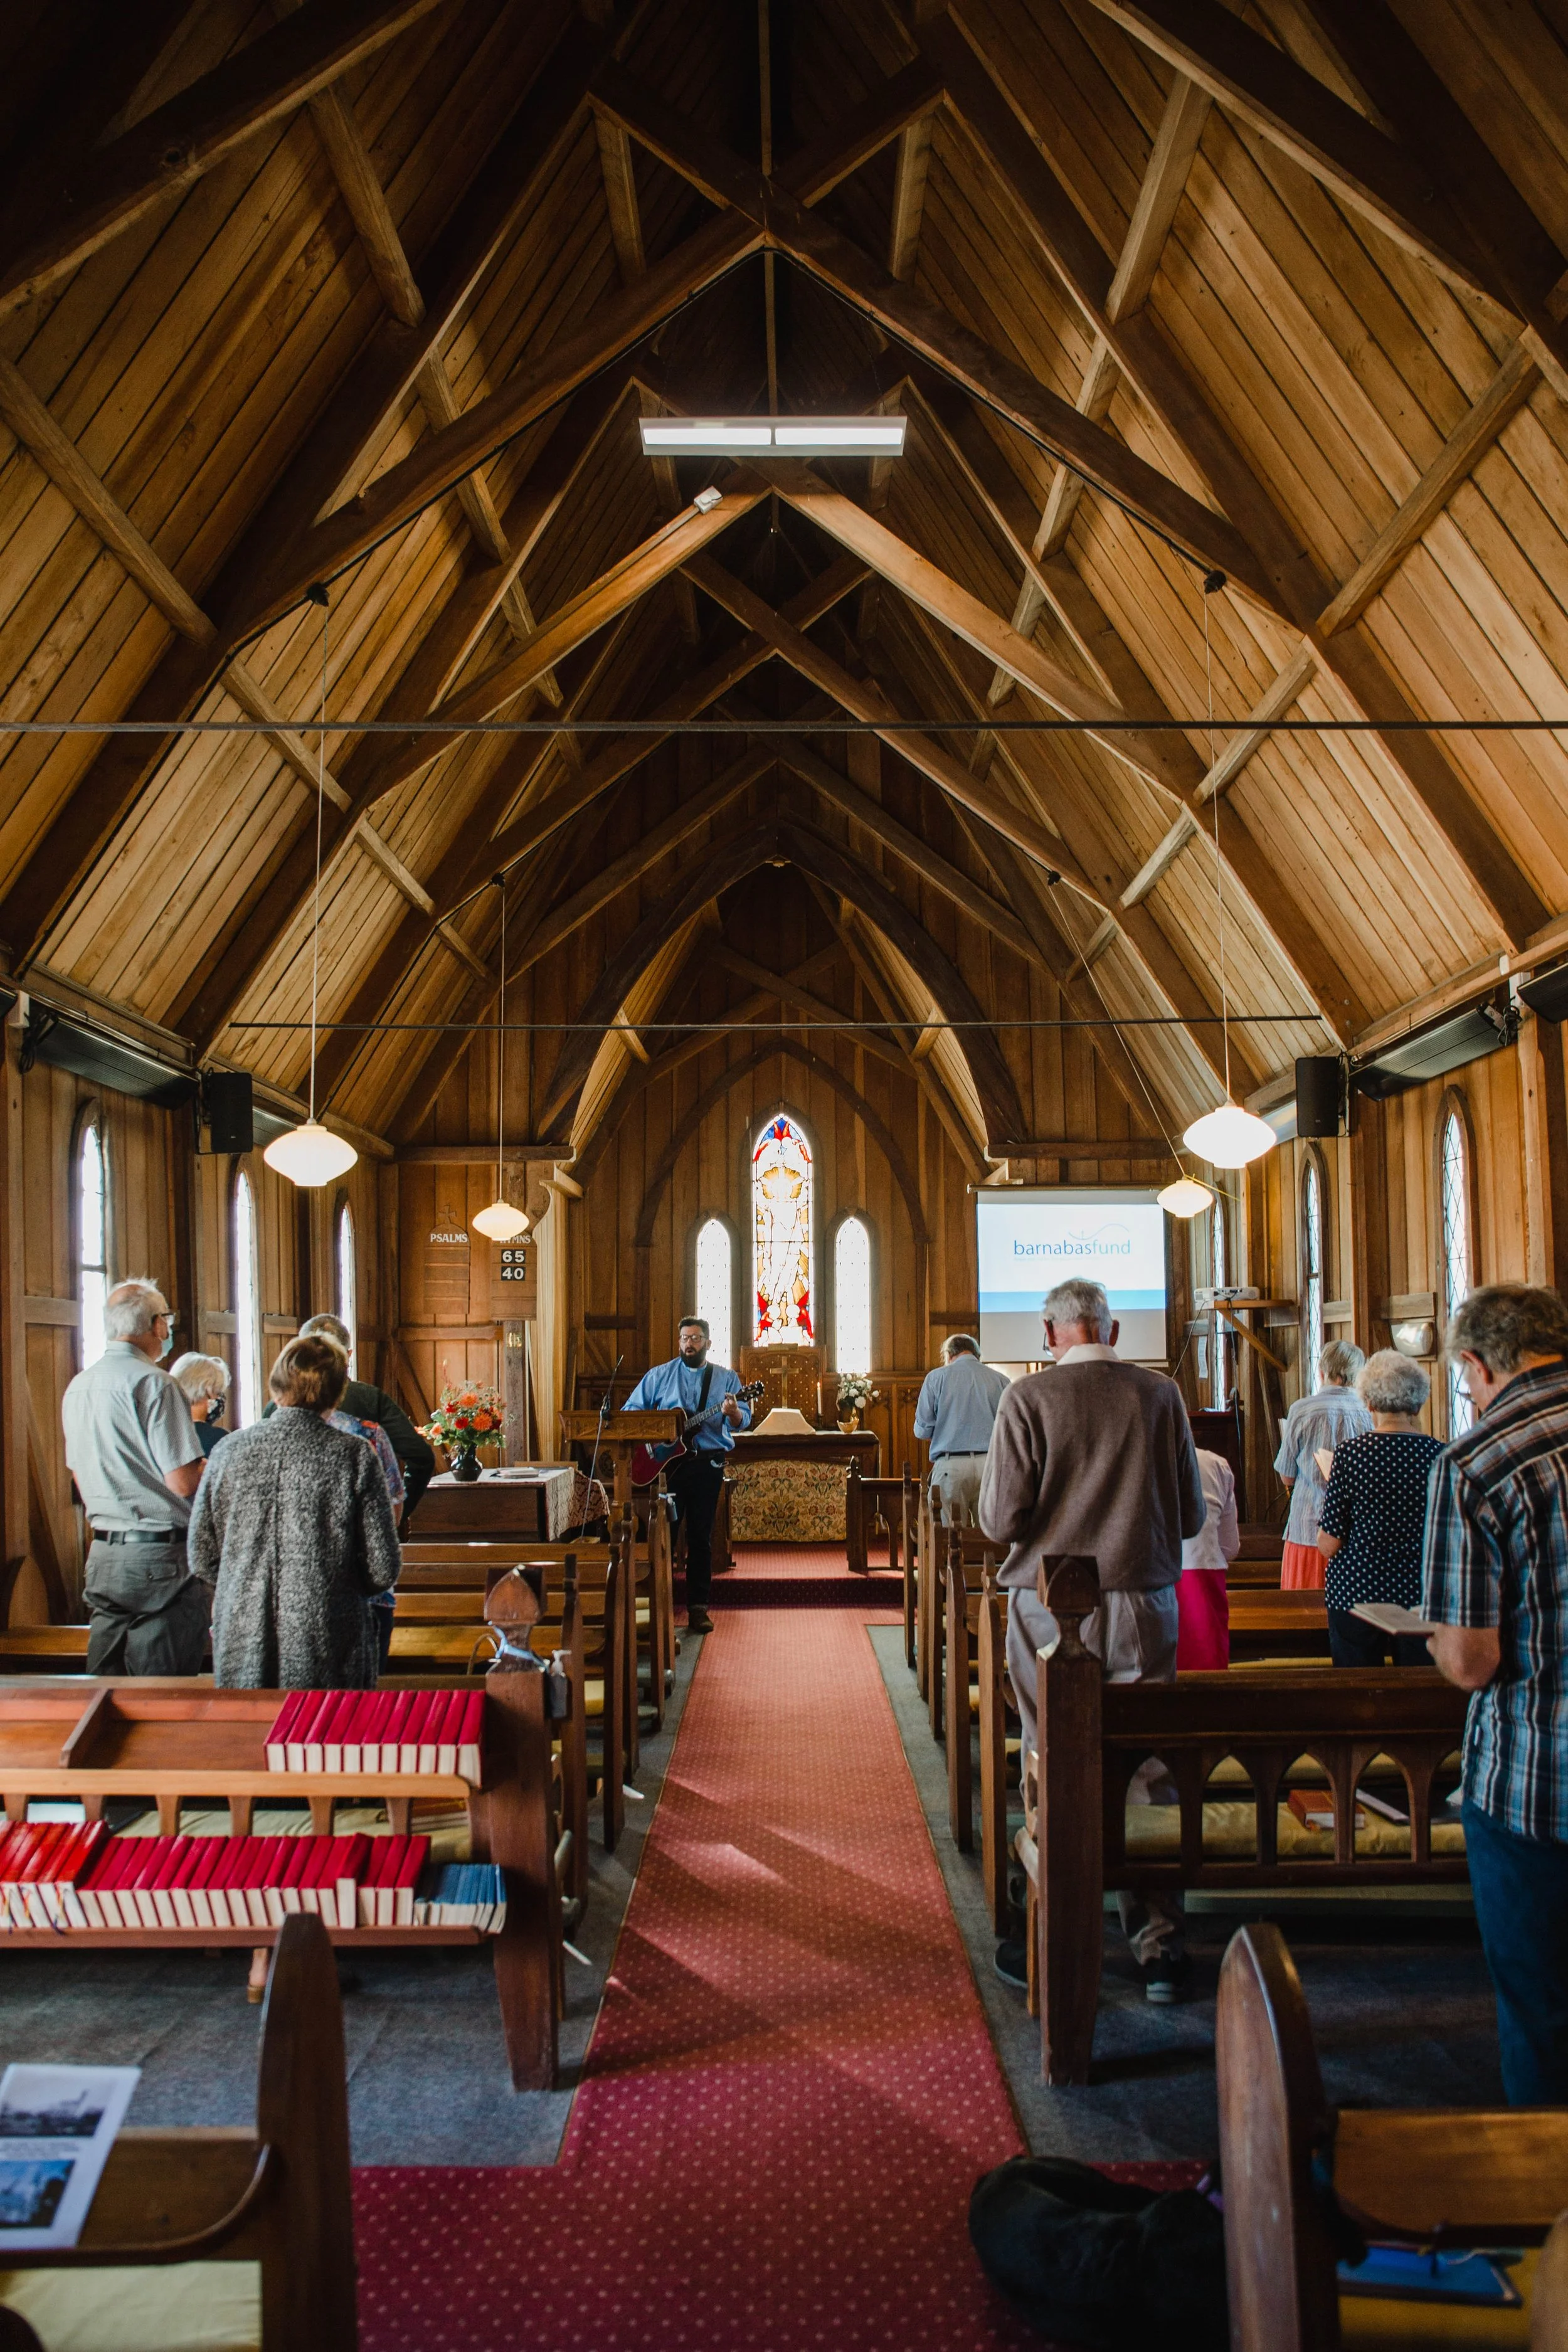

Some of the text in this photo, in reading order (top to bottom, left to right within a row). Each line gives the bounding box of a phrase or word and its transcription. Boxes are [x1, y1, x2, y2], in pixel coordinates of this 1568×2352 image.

[430, 1233, 468, 1242] PSALMS
[500, 1235, 531, 1244] MNS
[1014, 1239, 1130, 1255] barnabasfund
[502, 1250, 524, 1263] 65
[502, 1267, 524, 1279] 40
